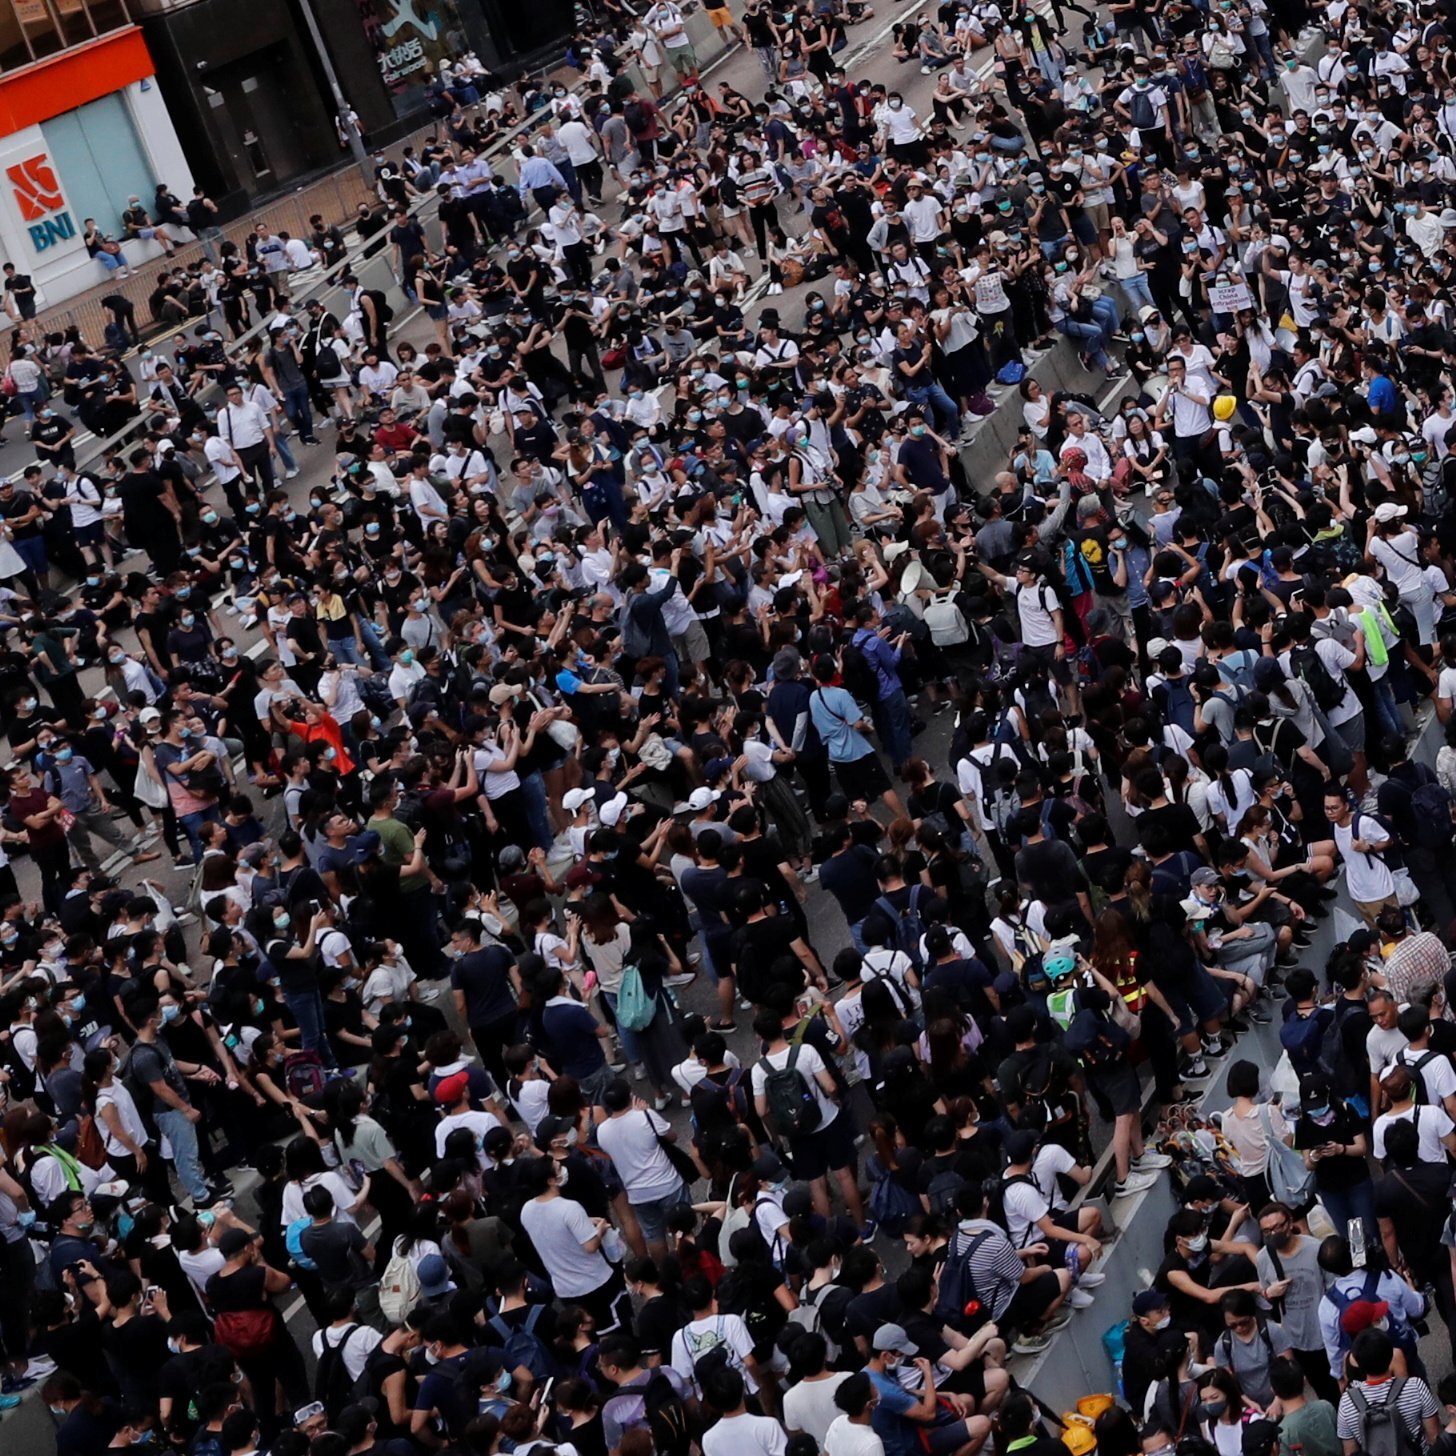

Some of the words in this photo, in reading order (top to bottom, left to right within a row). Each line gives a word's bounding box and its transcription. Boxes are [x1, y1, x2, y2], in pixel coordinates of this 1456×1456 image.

[377, 37, 423, 73] 大快活
[27, 211, 77, 253] BNI
